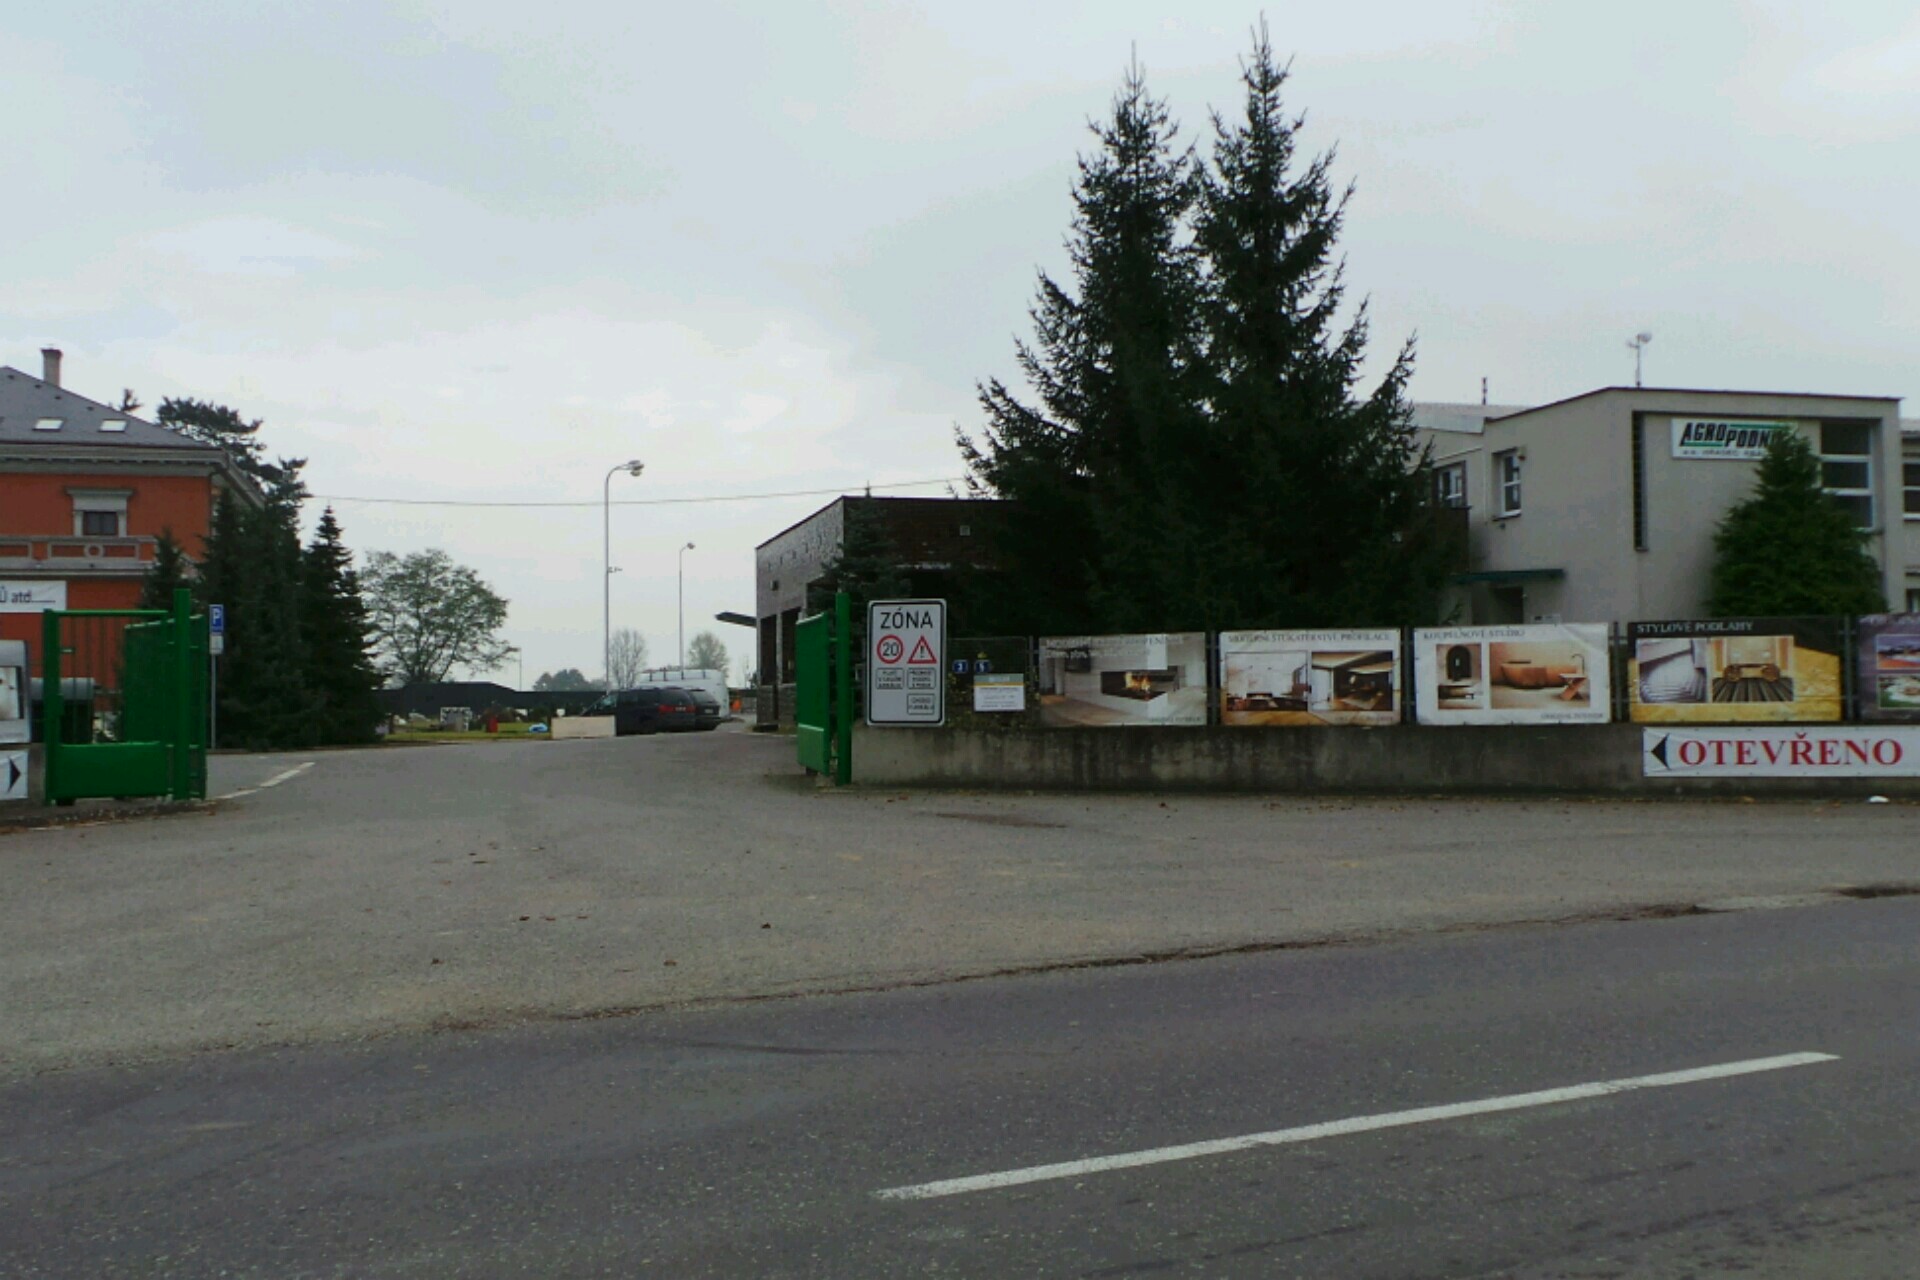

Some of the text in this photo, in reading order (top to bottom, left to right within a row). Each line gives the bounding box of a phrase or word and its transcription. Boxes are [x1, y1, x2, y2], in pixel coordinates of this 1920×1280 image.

[1679, 422, 1780, 448] AGROPODN
[880, 607, 933, 629] ZÓNA
[1695, 621, 1754, 633] PODLAHY
[882, 642, 899, 656] 20
[1679, 731, 1904, 766] OTEVŘENO
